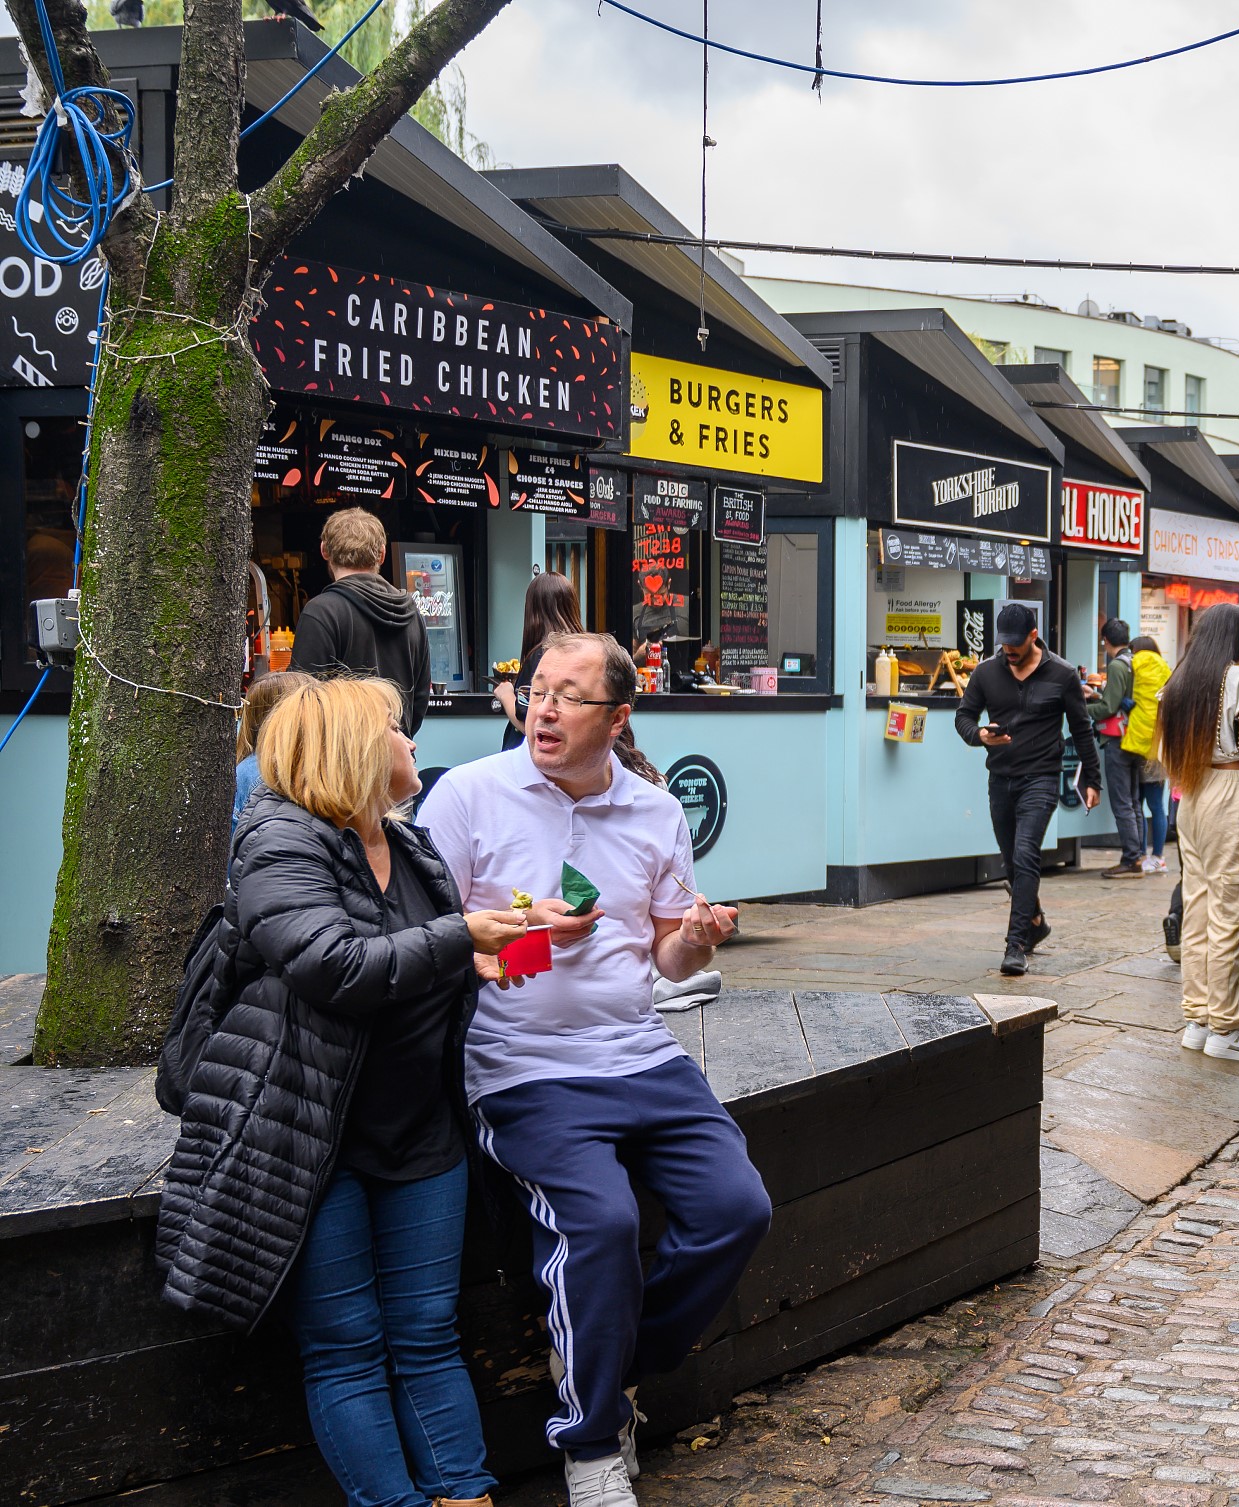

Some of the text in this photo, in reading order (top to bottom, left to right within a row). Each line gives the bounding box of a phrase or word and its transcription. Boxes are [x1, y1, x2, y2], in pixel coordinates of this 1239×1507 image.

[347, 294, 531, 358] CARIBBEAN
[314, 339, 570, 412] FRIED CHICKEN
[670, 378, 789, 424] BURGERS
[331, 433, 382, 447] MANGO BOX
[669, 418, 770, 459] & FRIES
[433, 448, 477, 460] MIXED BOX
[529, 454, 571, 467] JERK FRIES
[545, 466, 555, 474] £4
[516, 474, 584, 489] CHOOSE 2 SAUCES
[657, 479, 689, 498] BBC
[931, 467, 996, 506] YORKSHIRE
[644, 494, 661, 504] FOOD
[672, 497, 703, 511] FARMING
[723, 496, 753, 511] BRITISH
[973, 481, 1020, 518] BURRITO
[656, 507, 686, 519] AWARDS
[735, 511, 750, 521] FOOD
[1087, 491, 1141, 545] HOUSE
[895, 599, 941, 613] Food Allergy?
[678, 777, 708, 788] TONGUE
[679, 793, 705, 804] CHEEK
